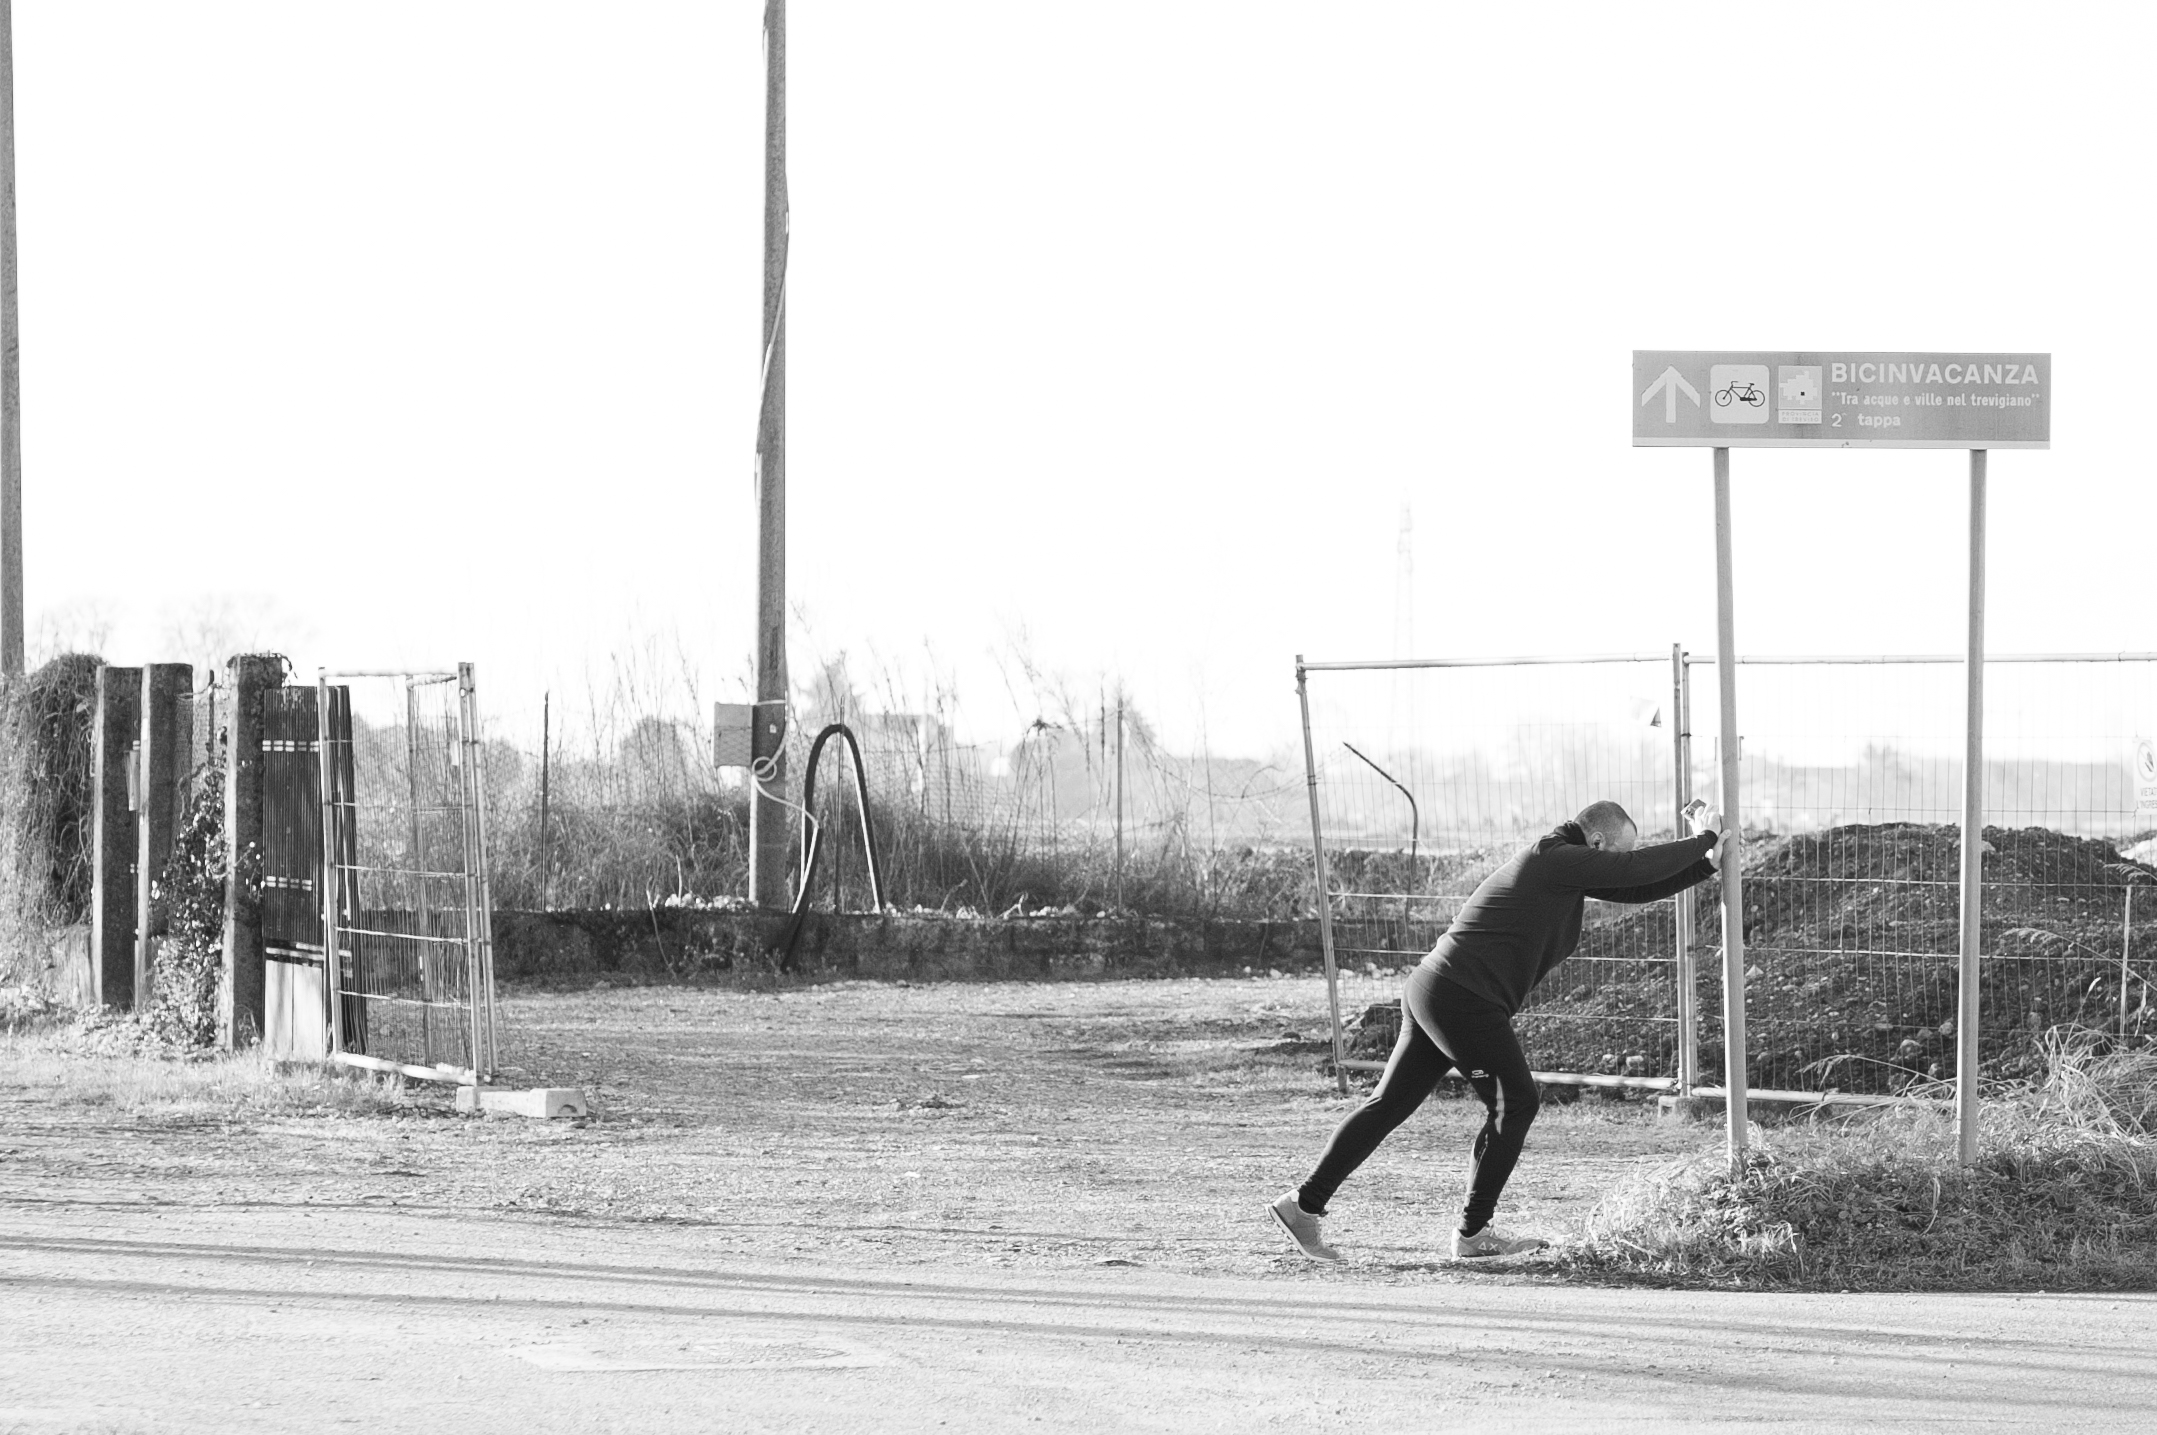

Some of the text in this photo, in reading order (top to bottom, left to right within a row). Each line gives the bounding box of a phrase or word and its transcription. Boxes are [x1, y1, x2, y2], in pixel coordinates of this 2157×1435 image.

[1831, 362, 2039, 384] BICINVACANZA
[1863, 395, 1899, 407] acque
[1903, 395, 1911, 405] e
[1914, 392, 1943, 406] ville
[1947, 392, 1967, 406] nel
[1857, 413, 1901, 428] tappa
